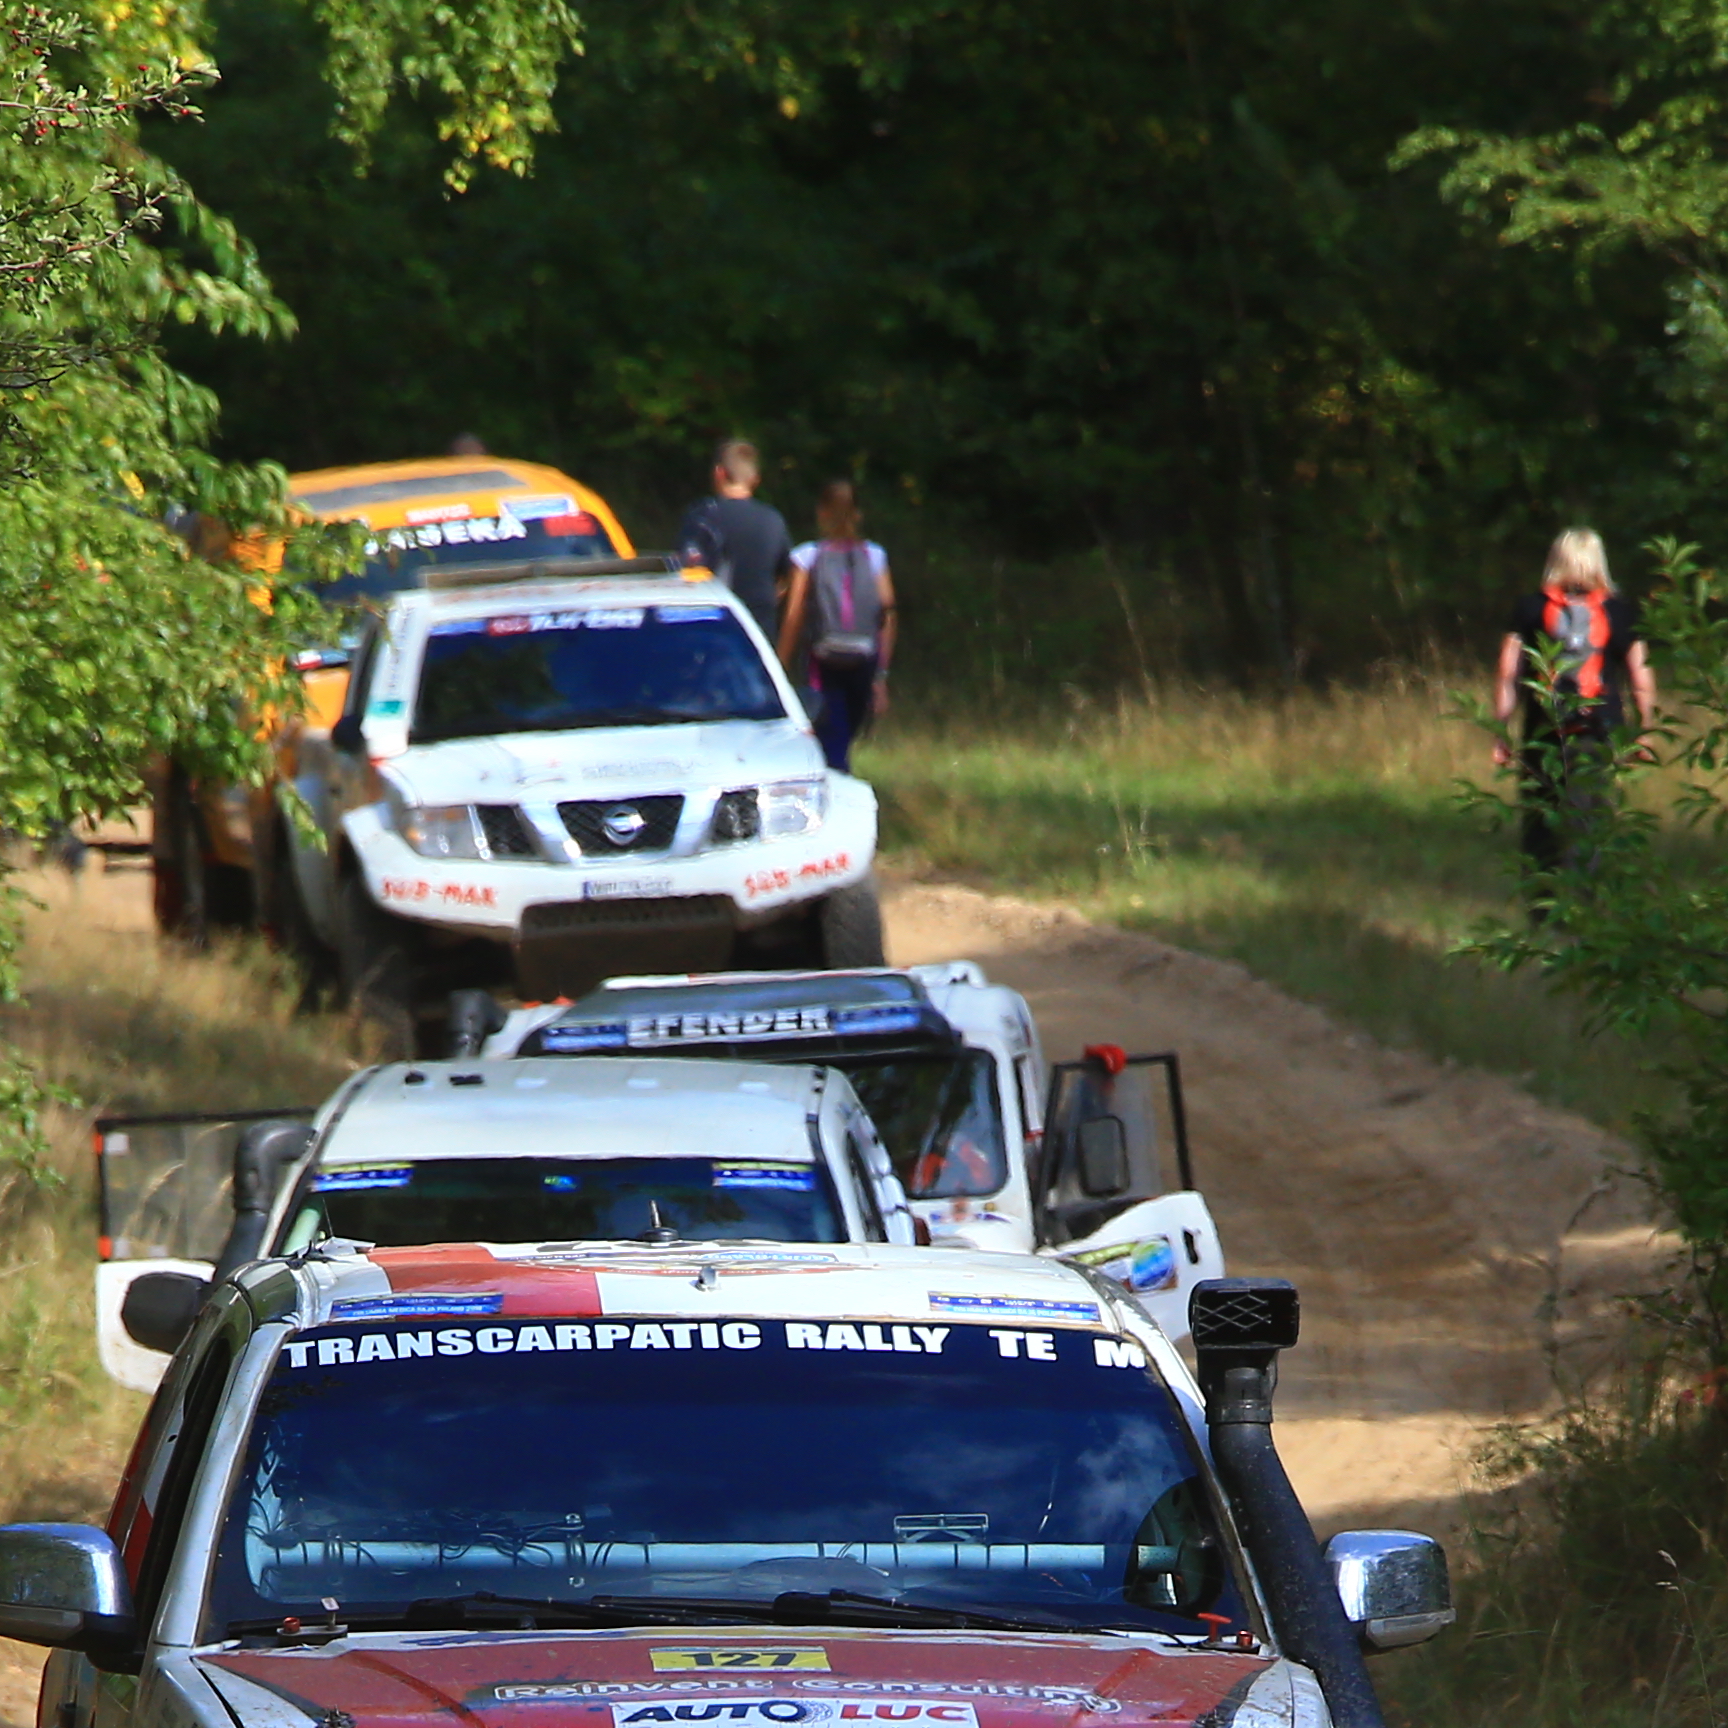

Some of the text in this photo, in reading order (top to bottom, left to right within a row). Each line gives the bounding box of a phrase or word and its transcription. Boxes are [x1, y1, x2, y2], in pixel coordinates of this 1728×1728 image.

[281, 1322, 761, 1368] TRANSCARPATIC
[785, 1322, 950, 1354] RALLY
[681, 1652, 797, 1668] 127
[619, 1700, 969, 1723] AUTO LUC
